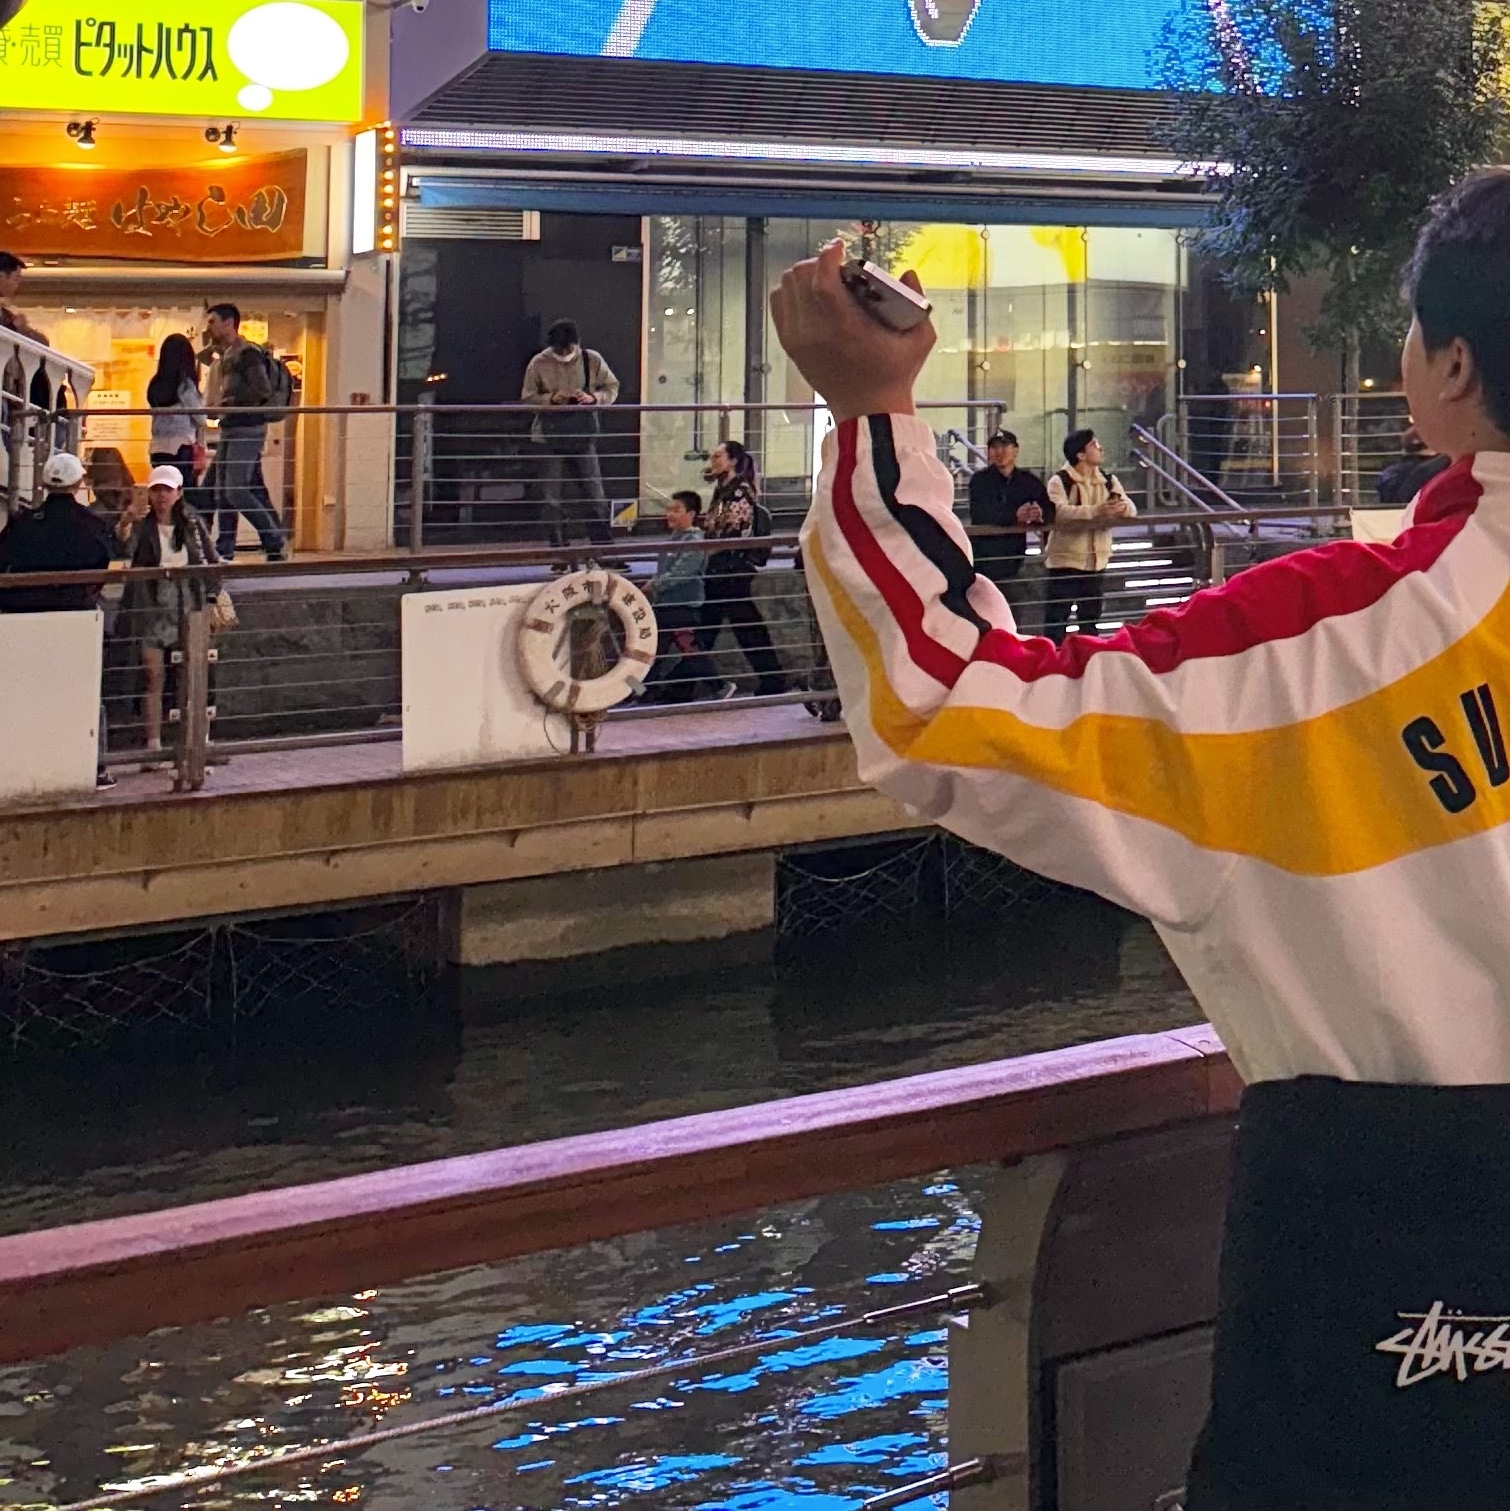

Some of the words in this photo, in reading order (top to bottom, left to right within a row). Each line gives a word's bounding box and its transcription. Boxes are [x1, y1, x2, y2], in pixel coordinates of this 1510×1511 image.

[73, 17, 219, 83] ピタットハウス
